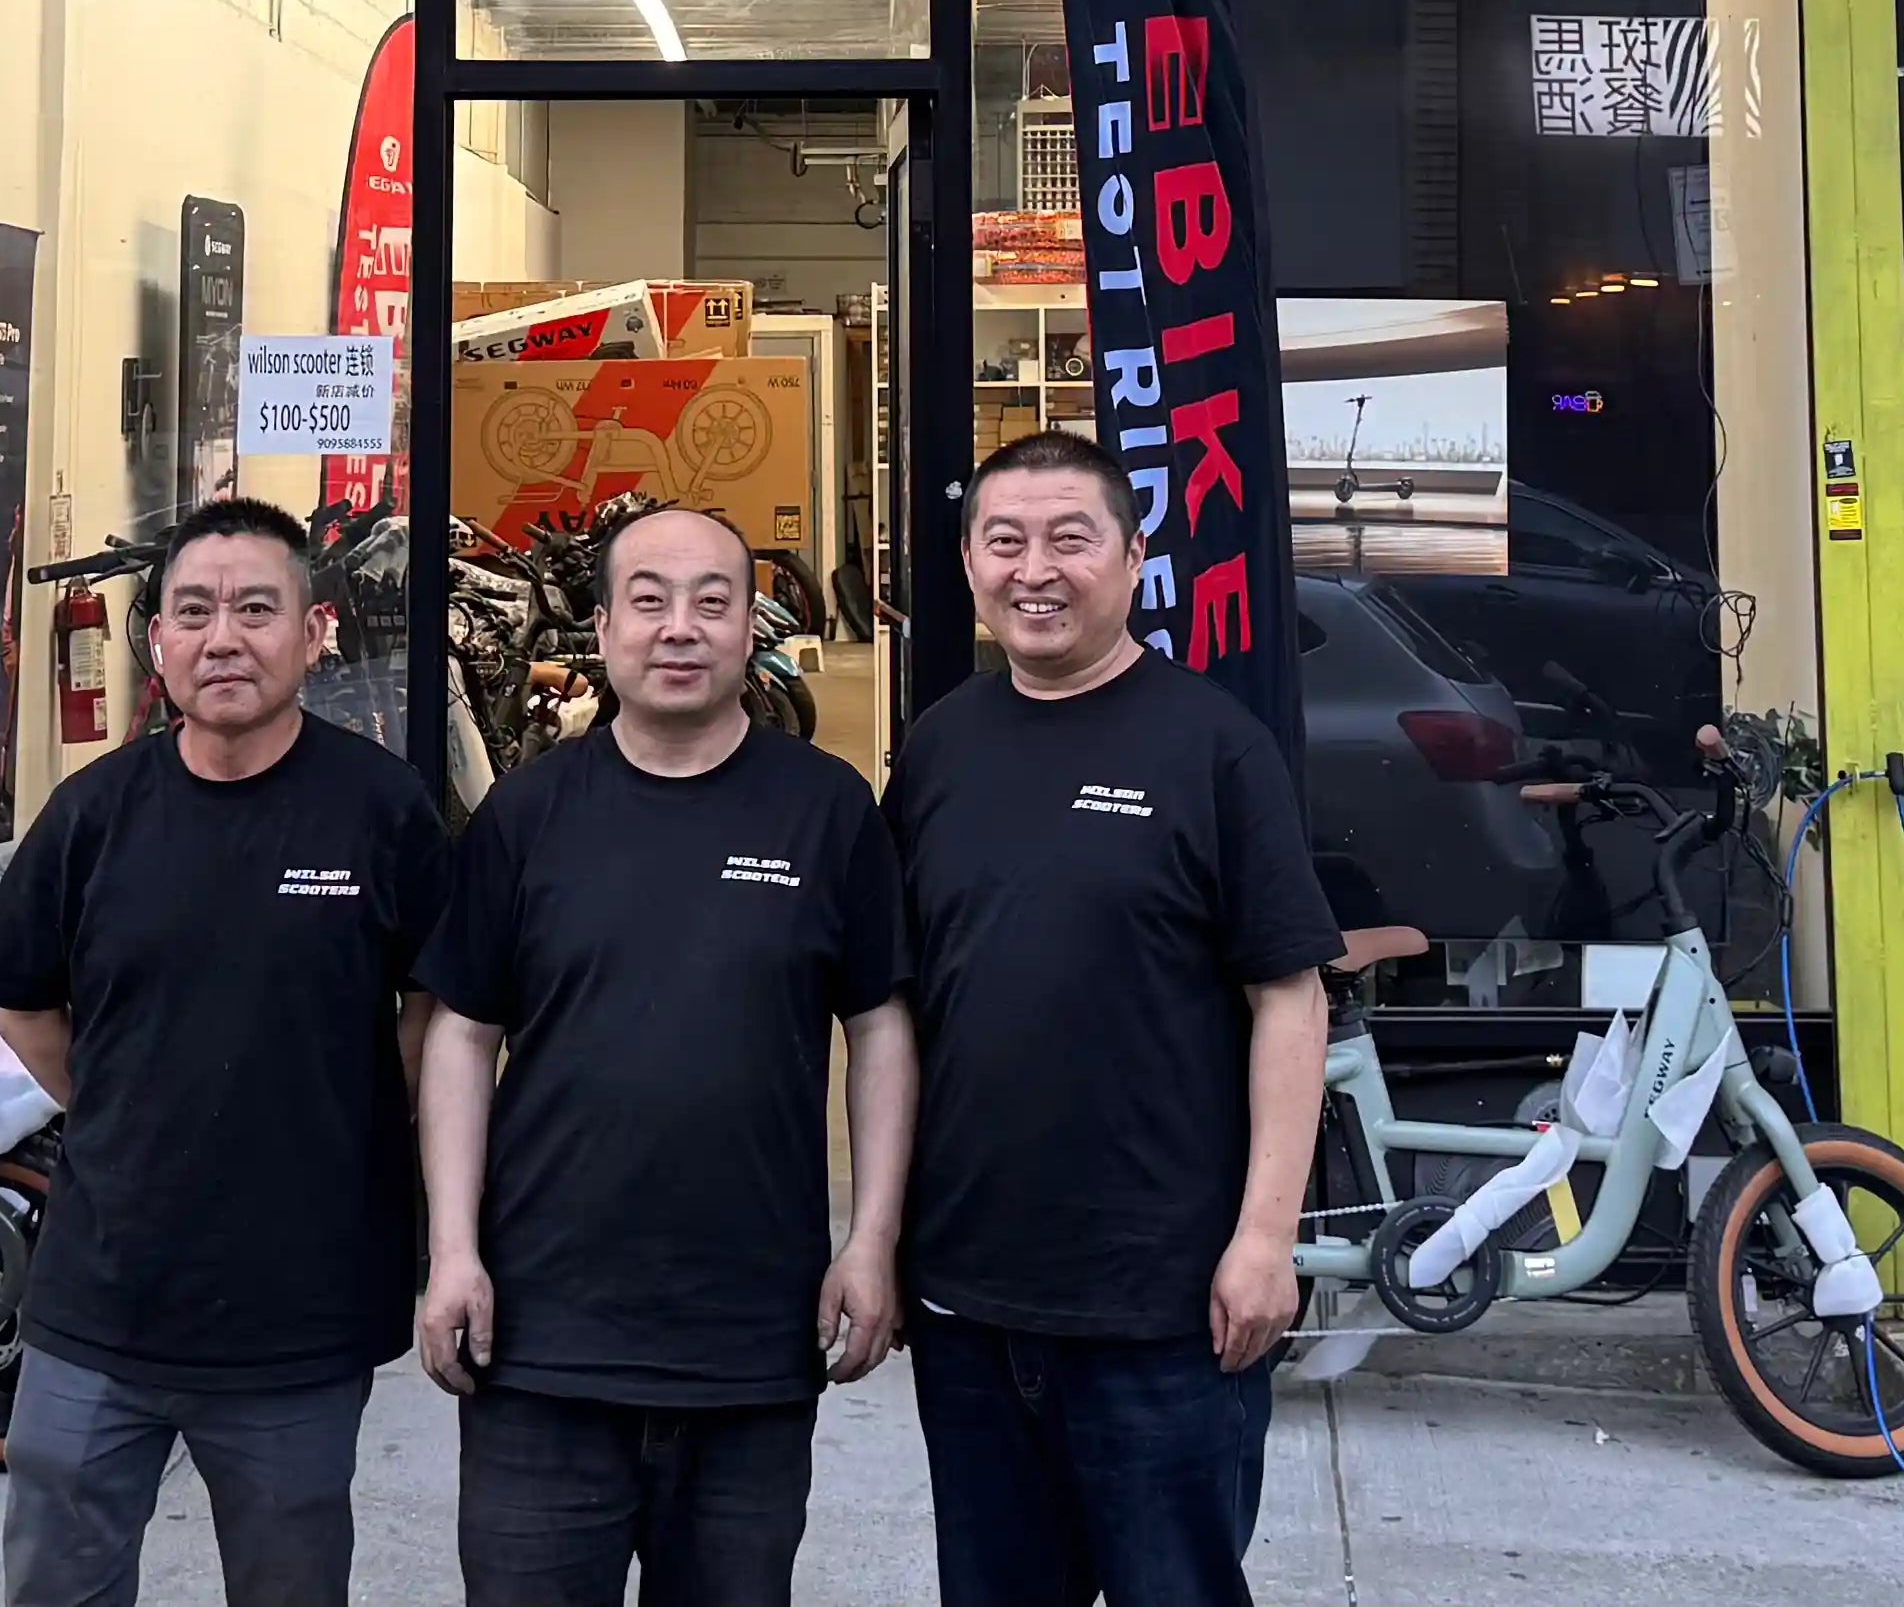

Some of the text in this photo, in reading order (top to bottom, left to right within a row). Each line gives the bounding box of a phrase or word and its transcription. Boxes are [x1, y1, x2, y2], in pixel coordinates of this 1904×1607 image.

[248, 345, 342, 375] wilson scooter
[464, 322, 594, 362] SEGWAY
[1144, 14, 1252, 674] EBIKE
[260, 401, 351, 434] $100-$500
